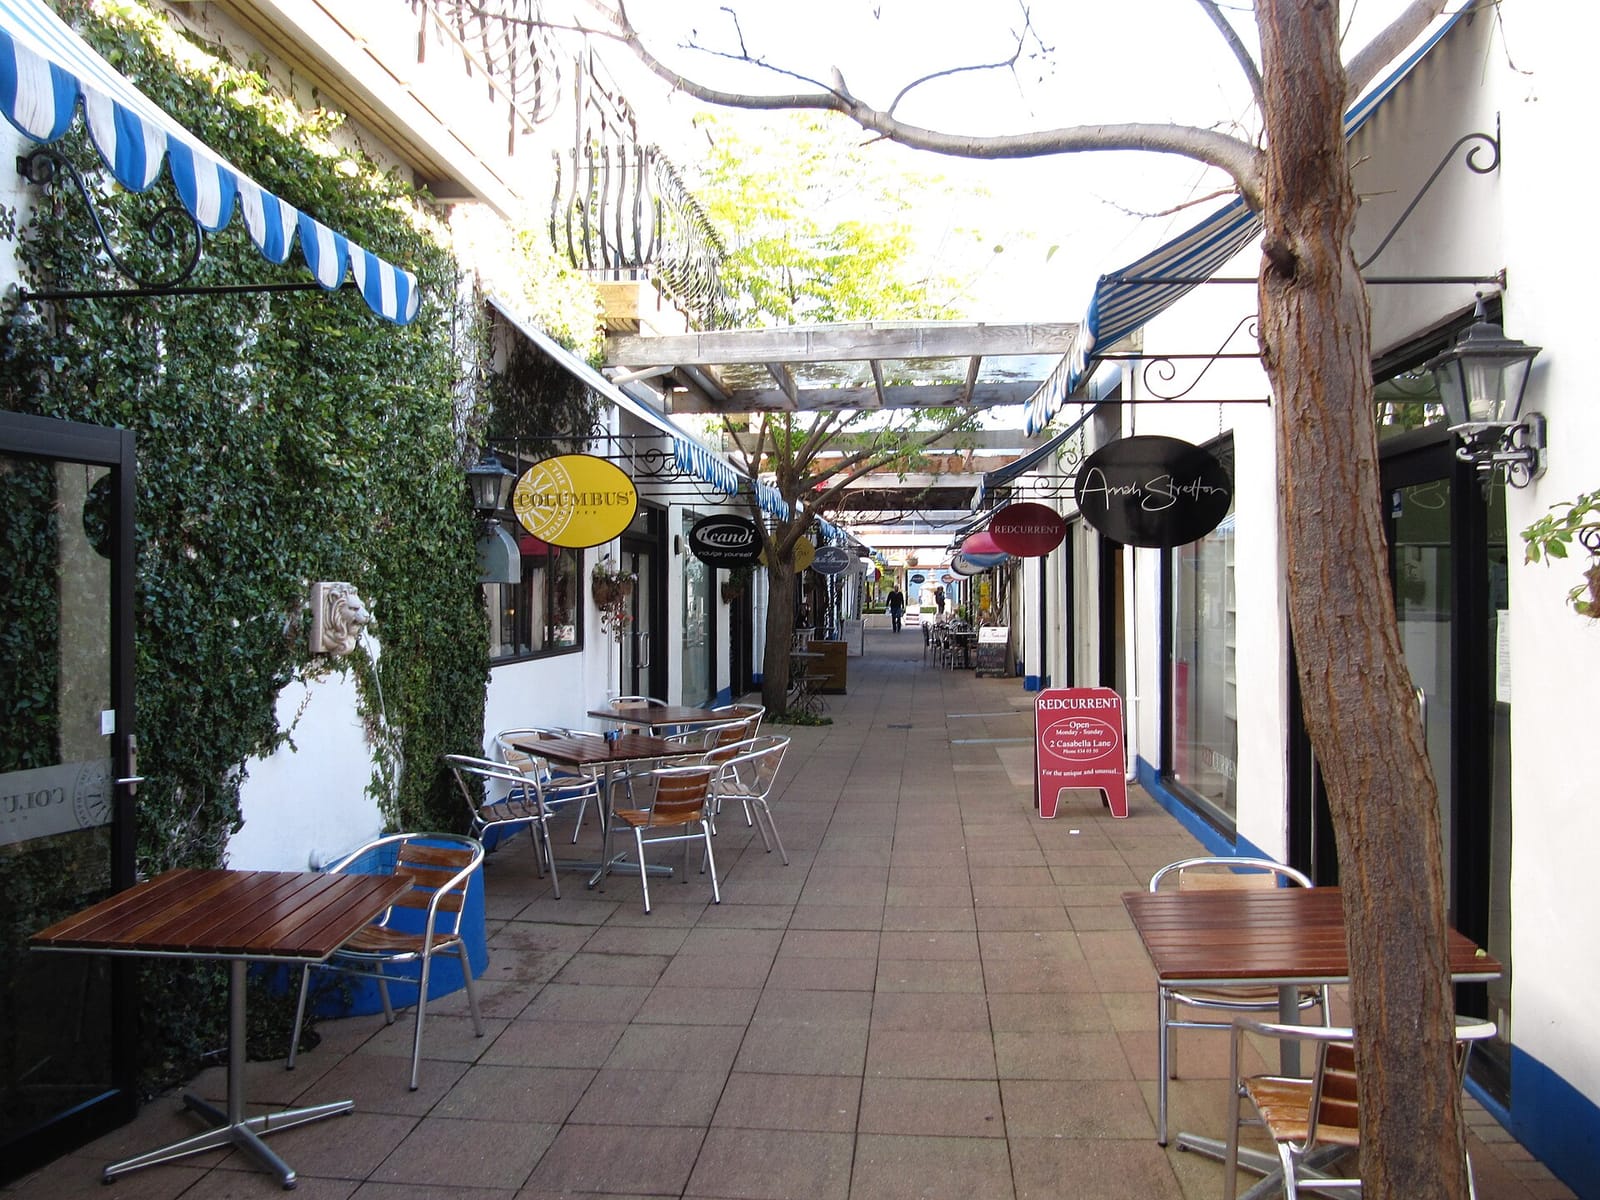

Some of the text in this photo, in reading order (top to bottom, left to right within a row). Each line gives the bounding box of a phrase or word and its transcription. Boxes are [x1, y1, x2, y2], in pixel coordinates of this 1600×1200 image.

[1141, 474, 1228, 512] Stretton
[518, 490, 630, 507] COLUMBUS
[994, 524, 1060, 535] REDCURRENT
[724, 550, 753, 558] yourself
[1038, 697, 1119, 710] REDCURRENT
[1069, 720, 1090, 730] Open
[1083, 728, 1104, 736] Sunday
[1056, 739, 1091, 747] Casabella
[1042, 768, 1052, 776] For
[1063, 769, 1082, 777] unique
